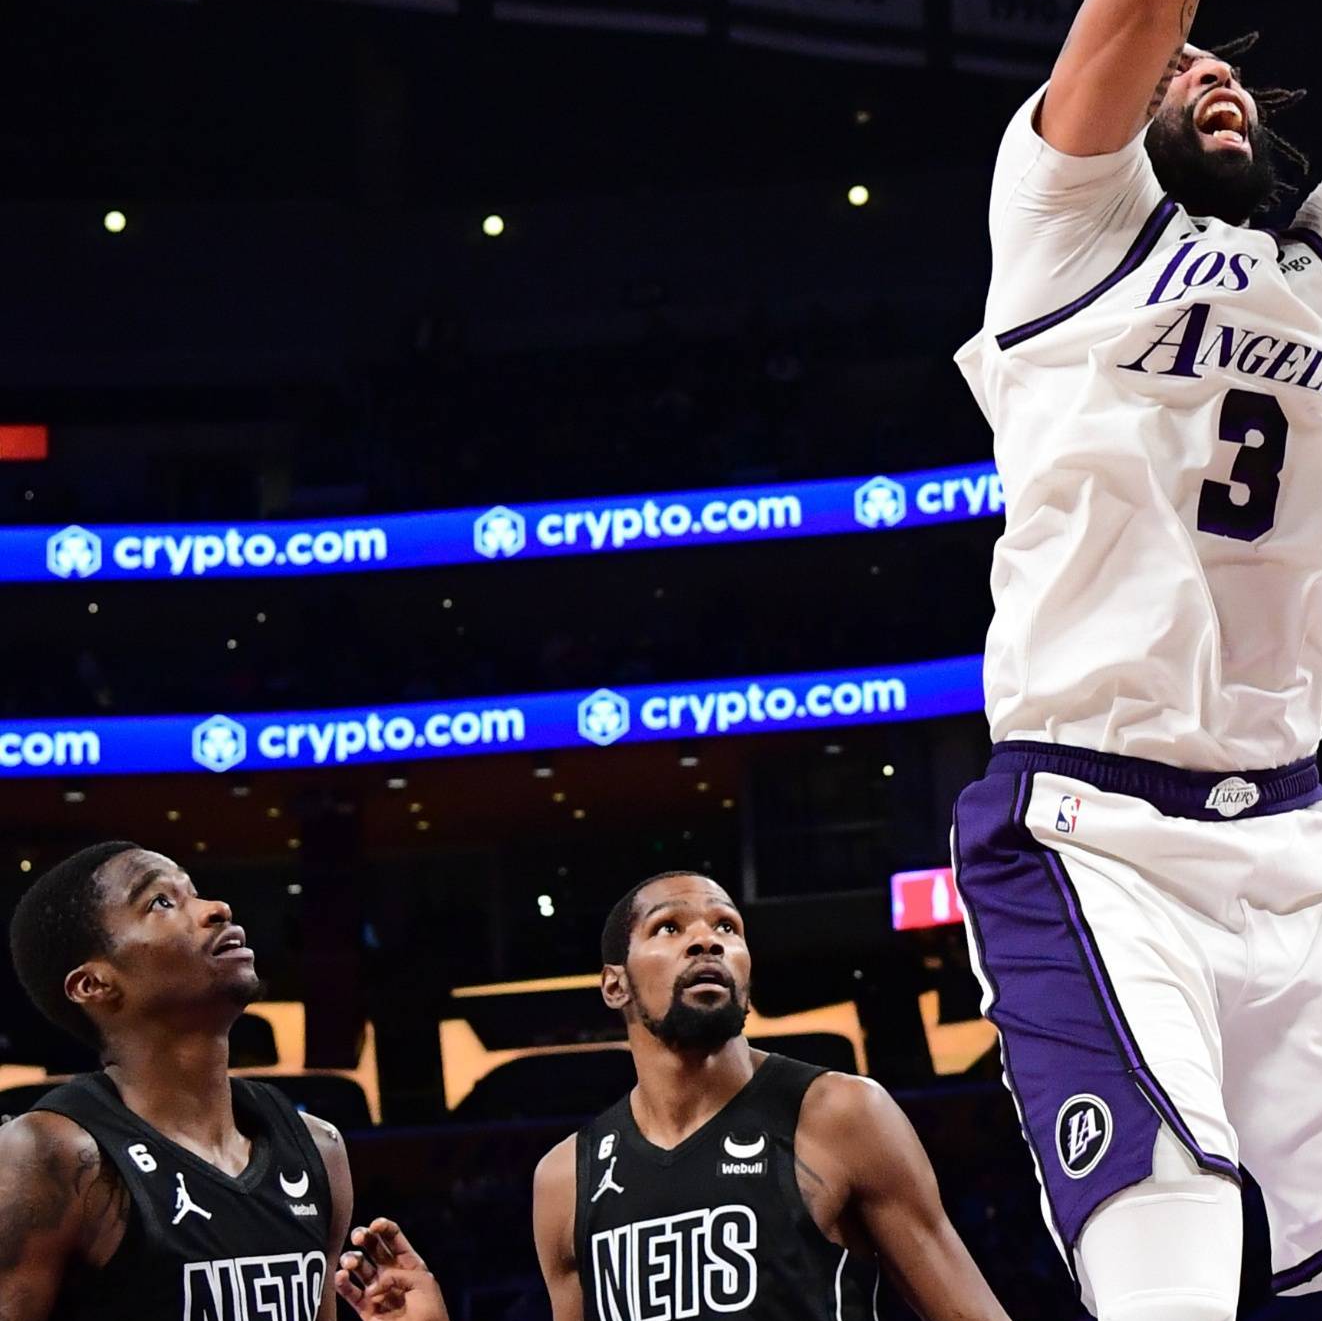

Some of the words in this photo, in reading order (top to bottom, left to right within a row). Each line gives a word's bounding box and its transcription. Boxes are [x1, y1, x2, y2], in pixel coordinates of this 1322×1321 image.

[1197, 388, 1289, 543] 3
[536, 495, 802, 549] crypto.com
[114, 526, 387, 576] crypto.com
[640, 678, 906, 733] crypto.com
[257, 708, 525, 764] crypto.com
[128, 1143, 157, 1173] 6
[597, 1133, 617, 1162] 6
[721, 1162, 763, 1175] Webull
